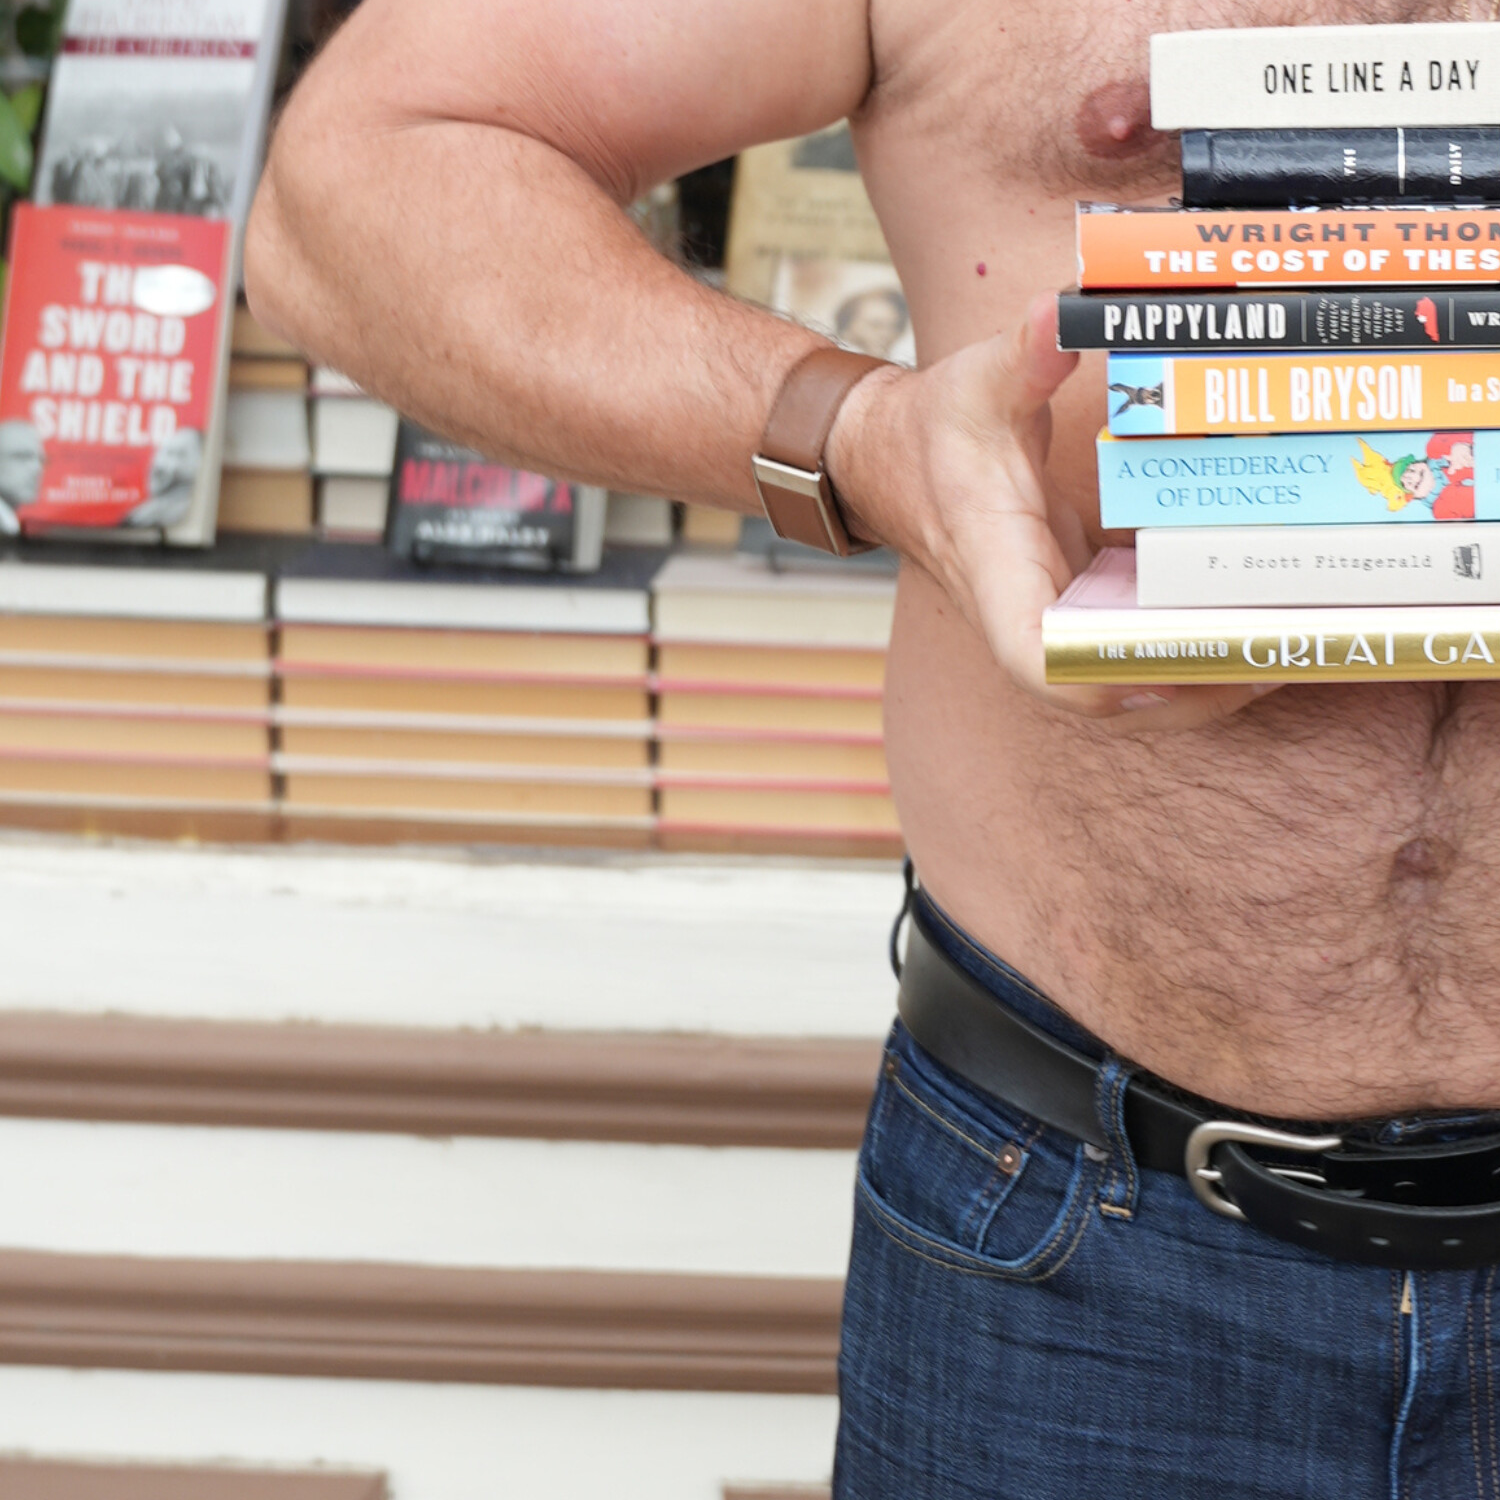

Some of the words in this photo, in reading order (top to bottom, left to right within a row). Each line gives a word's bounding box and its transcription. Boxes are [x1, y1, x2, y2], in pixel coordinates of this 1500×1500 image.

[1264, 63, 1313, 94] ONE
[1328, 61, 1385, 93] LINE
[1400, 61, 1414, 92] A
[1429, 59, 1480, 91] DAY
[1344, 147, 1357, 177] THE
[1449, 142, 1462, 186] DAILY
[1196, 222, 1376, 243] WRIGHT
[1144, 250, 1217, 273] THE
[1231, 249, 1330, 272] COST
[1343, 249, 1390, 272] OF
[79, 259, 137, 306] TH
[40, 304, 187, 357] SWORD
[1104, 302, 1287, 342] PAPPYLAND
[1340, 308, 1350, 333] FINE
[1373, 301, 1383, 339] THINGS
[1384, 306, 1394, 334] THAT
[1395, 307, 1405, 333] LAST
[19, 349, 105, 398] AND
[115, 355, 195, 404] THE
[1205, 367, 1276, 424] BILL
[1290, 364, 1423, 422] BRYSON
[1447, 377, 1467, 403] In
[1471, 383, 1483, 402] a
[29, 398, 178, 447] SHIELD
[1118, 459, 1136, 479] A
[1141, 454, 1334, 478] CONFEDERACY
[1156, 487, 1191, 508] OF
[1197, 485, 1302, 507] DUNCES
[1207, 555, 1228, 570] F.
[1243, 555, 1302, 570] Scott
[1315, 554, 1432, 572] Fitzgerald
[1098, 641, 1127, 659] THE
[1134, 640, 1229, 659] ANNOTATED
[1242, 632, 1396, 668] GREAT
